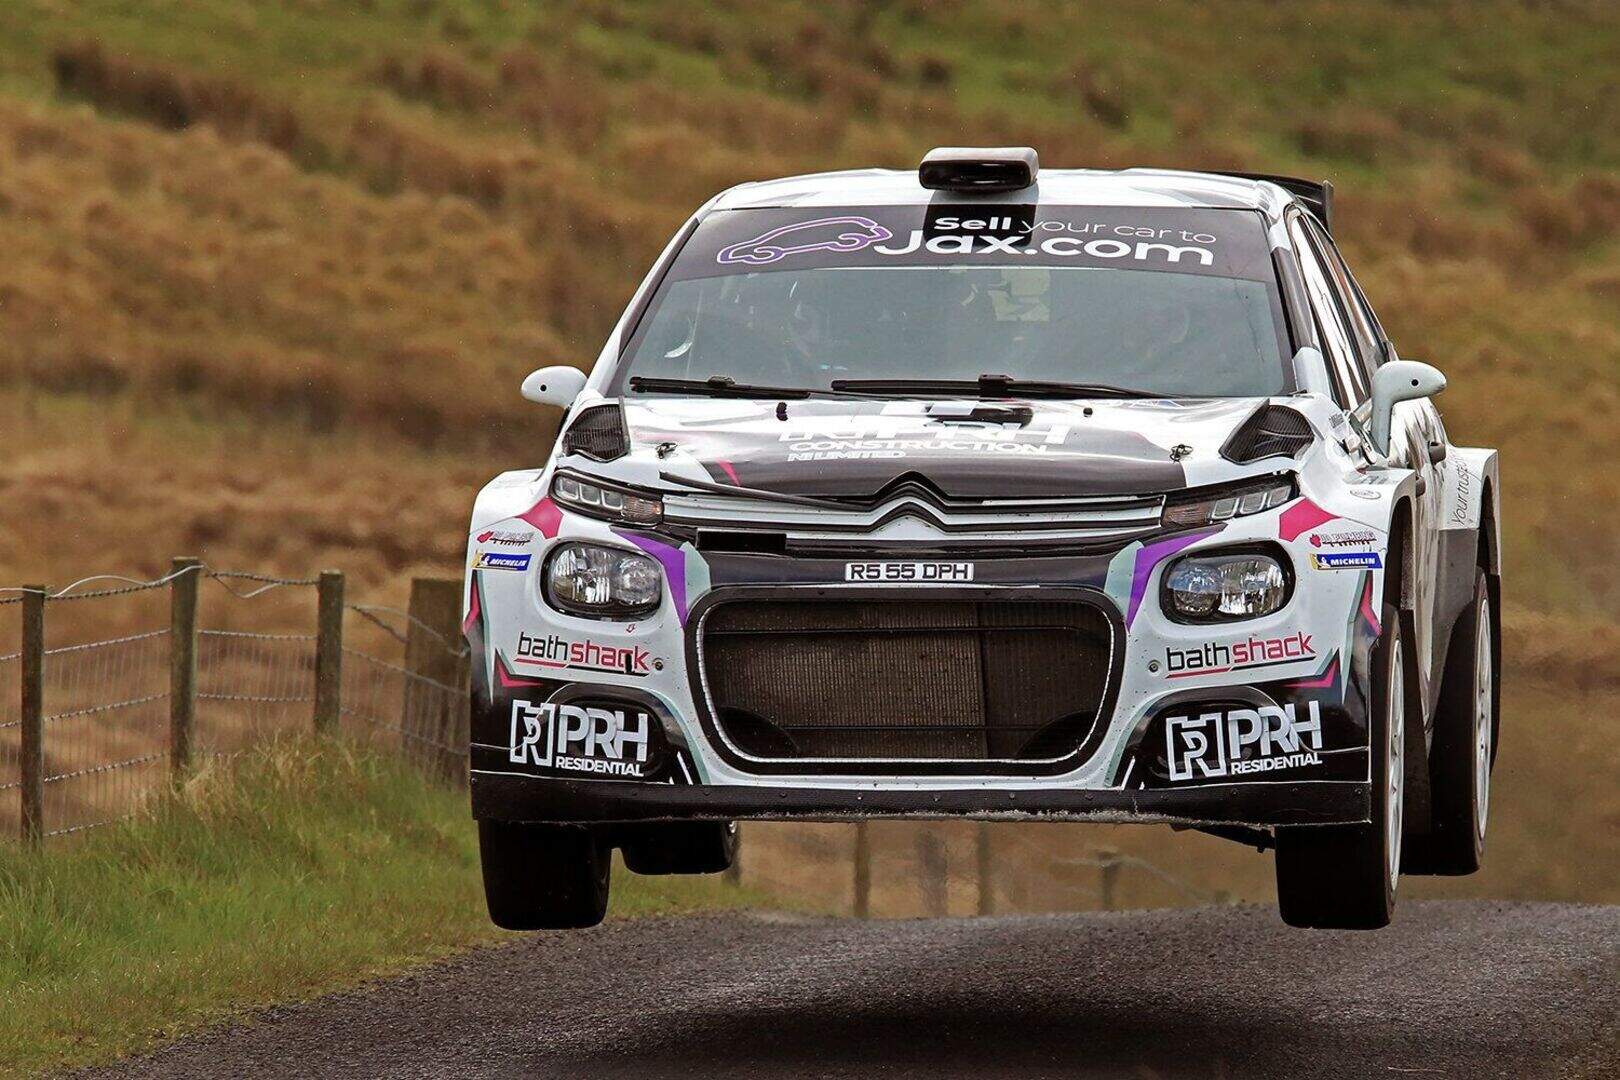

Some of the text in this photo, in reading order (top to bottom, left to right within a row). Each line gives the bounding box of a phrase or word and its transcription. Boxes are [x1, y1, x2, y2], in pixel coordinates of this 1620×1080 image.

[933, 216, 1216, 244] Sell your car to
[873, 229, 1214, 265] Jax.com
[789, 439, 1049, 454] CONSTRUCTION
[814, 449, 907, 460] LIMITED
[1451, 494, 1468, 525] Your
[489, 557, 528, 567] MICHELIN
[850, 563, 969, 580] R5 55 DPH
[1330, 557, 1376, 566] MICHELIN
[556, 704, 649, 762] PRH
[1228, 700, 1323, 760] PRH
[555, 756, 645, 777] RESIDENTIAL
[1230, 752, 1323, 776] RESIDENTIAL
